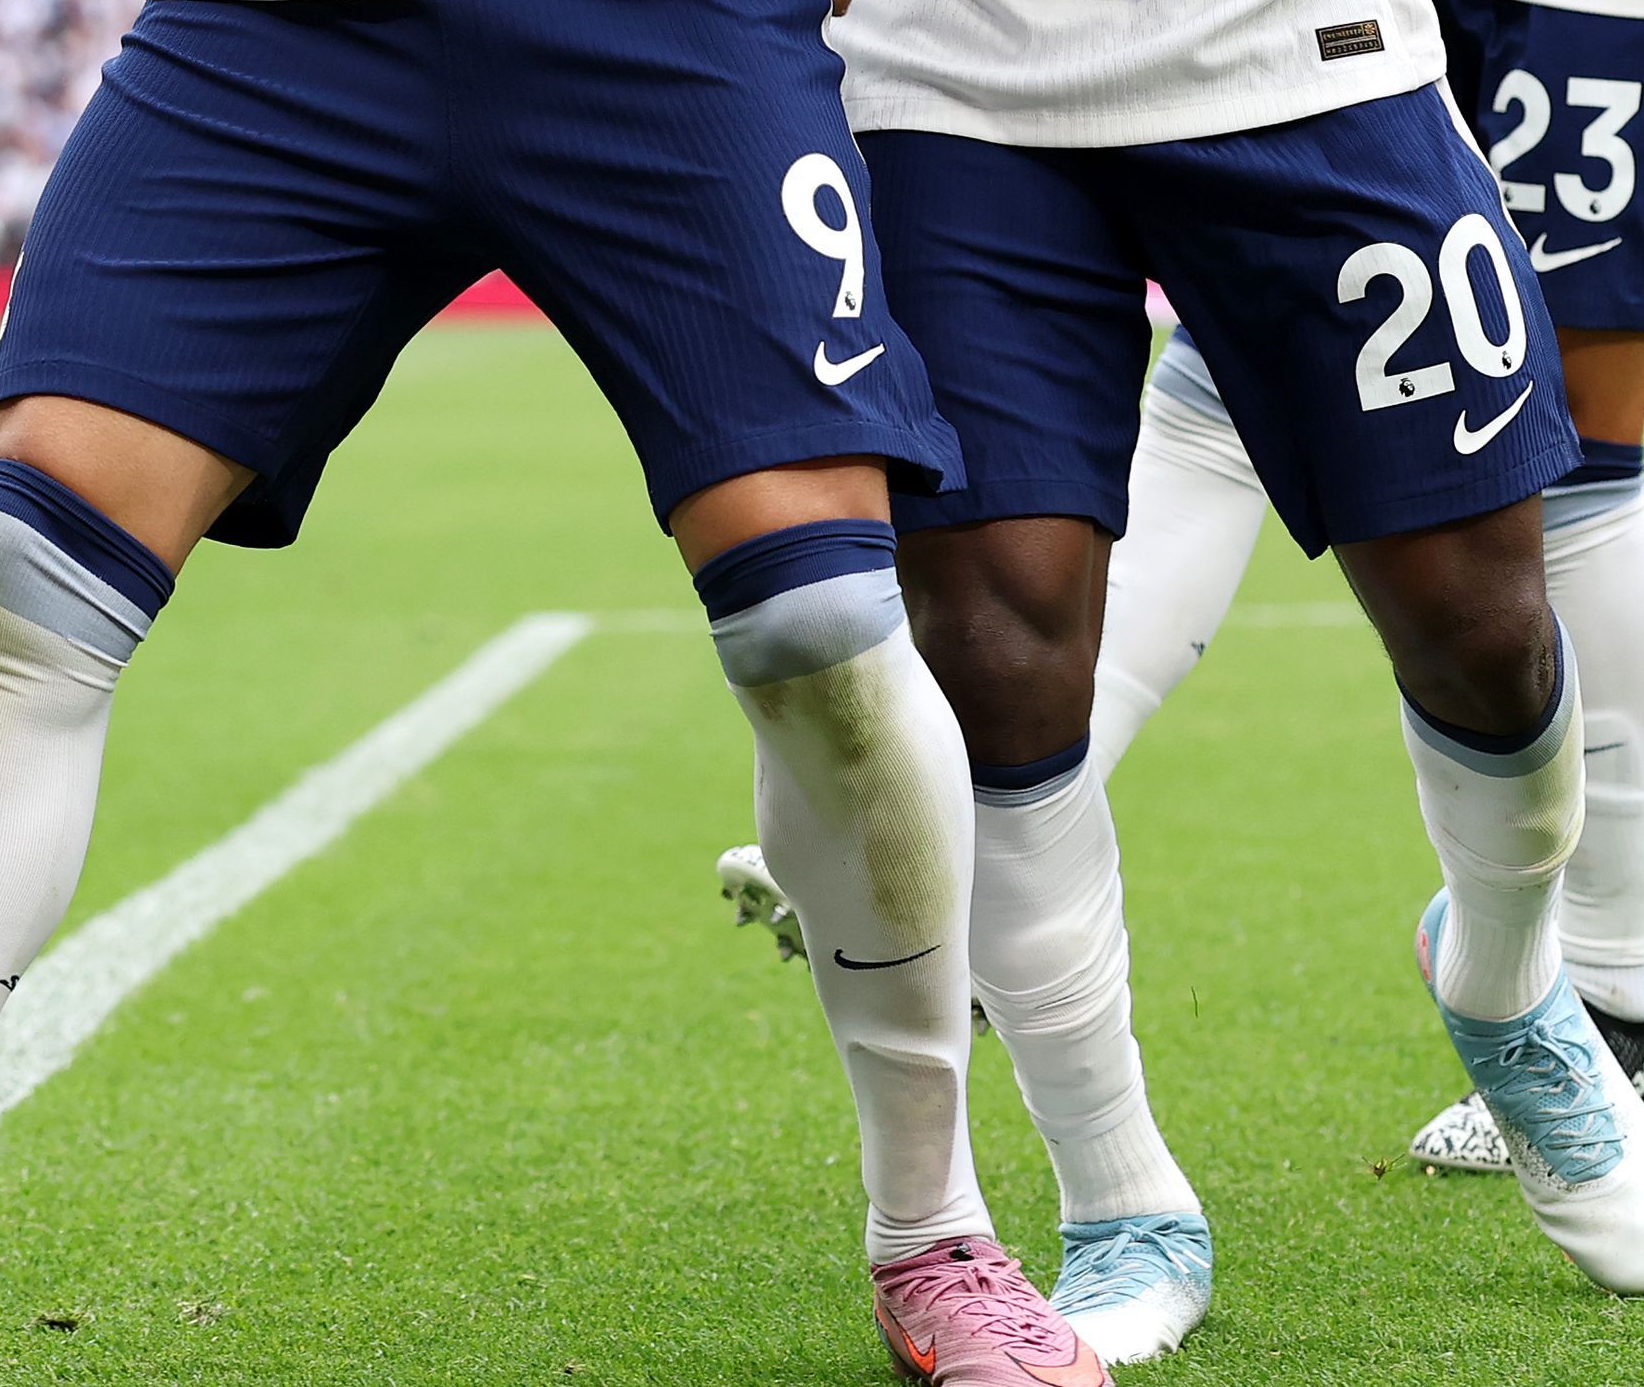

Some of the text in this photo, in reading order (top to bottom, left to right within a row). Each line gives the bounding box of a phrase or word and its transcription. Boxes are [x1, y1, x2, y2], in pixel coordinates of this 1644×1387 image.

[1489, 68, 1642, 223] 23
[781, 152, 864, 318] 9
[1337, 213, 1528, 412] 20
